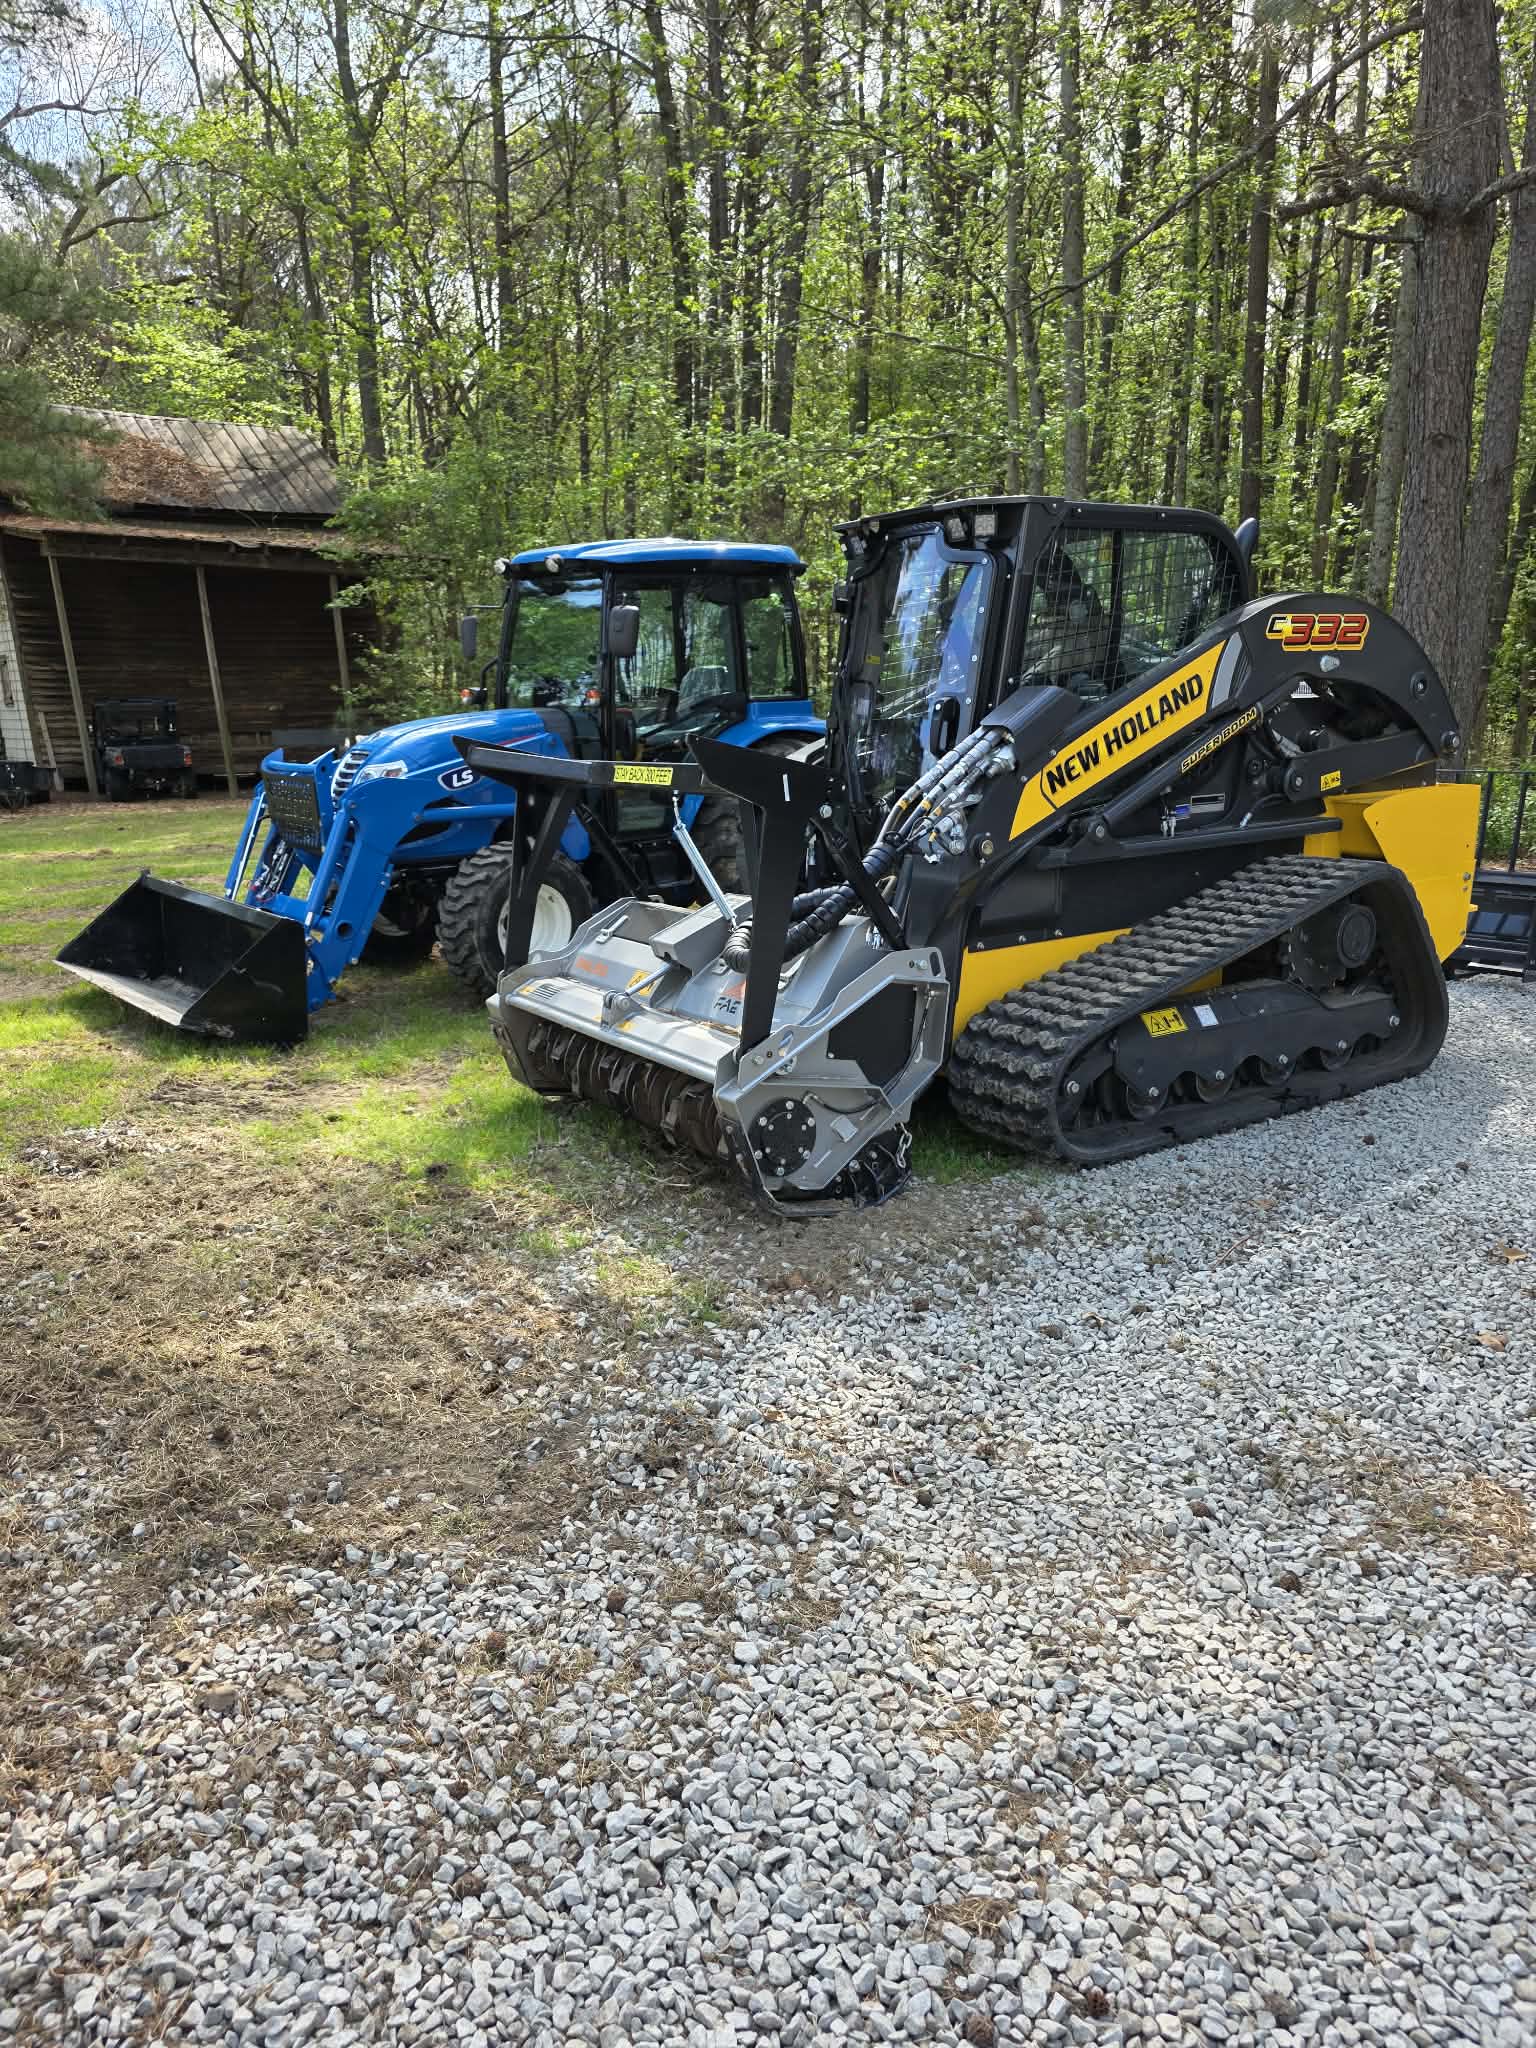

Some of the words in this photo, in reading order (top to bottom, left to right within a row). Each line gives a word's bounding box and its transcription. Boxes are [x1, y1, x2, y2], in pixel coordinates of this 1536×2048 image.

[1266, 614, 1369, 650] C332
[1046, 738, 1100, 794] NEW
[1103, 674, 1204, 757] HOLLAND
[1182, 735, 1222, 772] SUPER
[1222, 707, 1257, 741] BOOM
[452, 769, 474, 788] LS
[713, 996, 742, 1014] FAE
